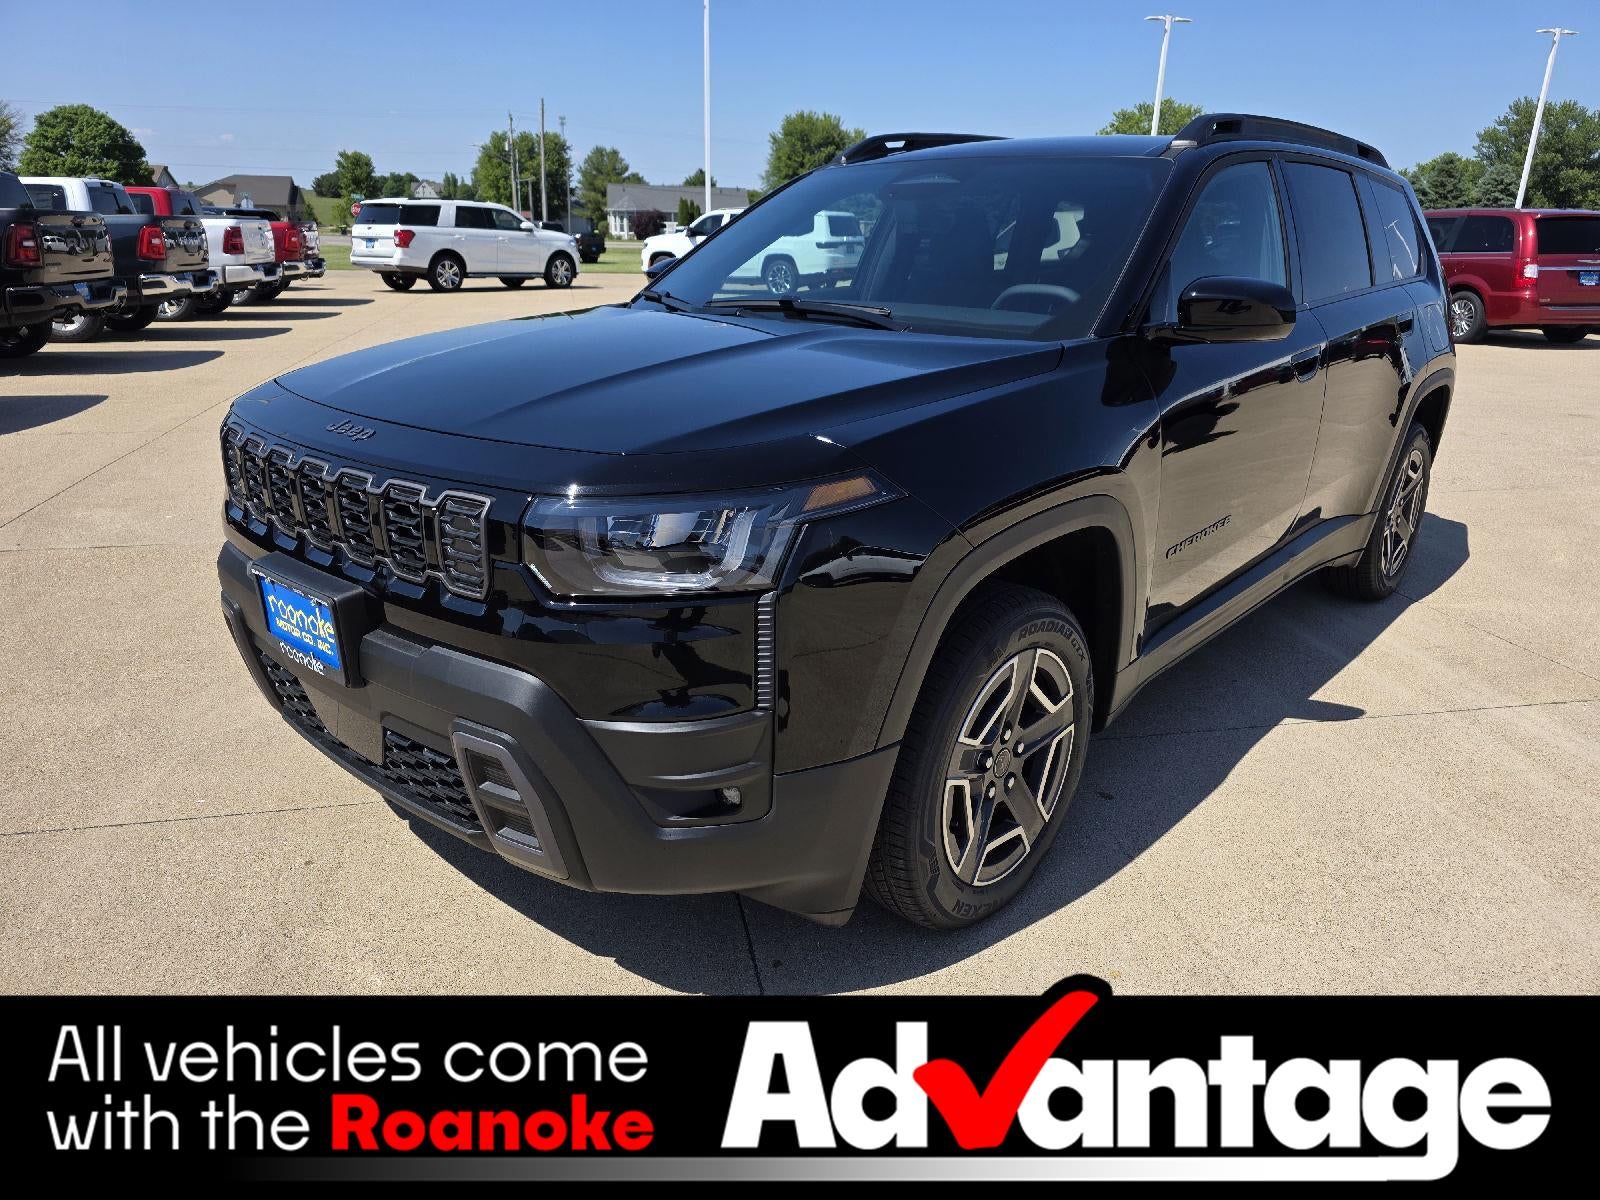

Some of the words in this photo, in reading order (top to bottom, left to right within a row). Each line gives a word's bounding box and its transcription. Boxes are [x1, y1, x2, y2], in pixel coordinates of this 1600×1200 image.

[326, 419, 377, 442] Jeep
[1165, 514, 1232, 559] CHEROKEE
[267, 595, 335, 643] roanoke
[279, 640, 325, 676] roanoke
